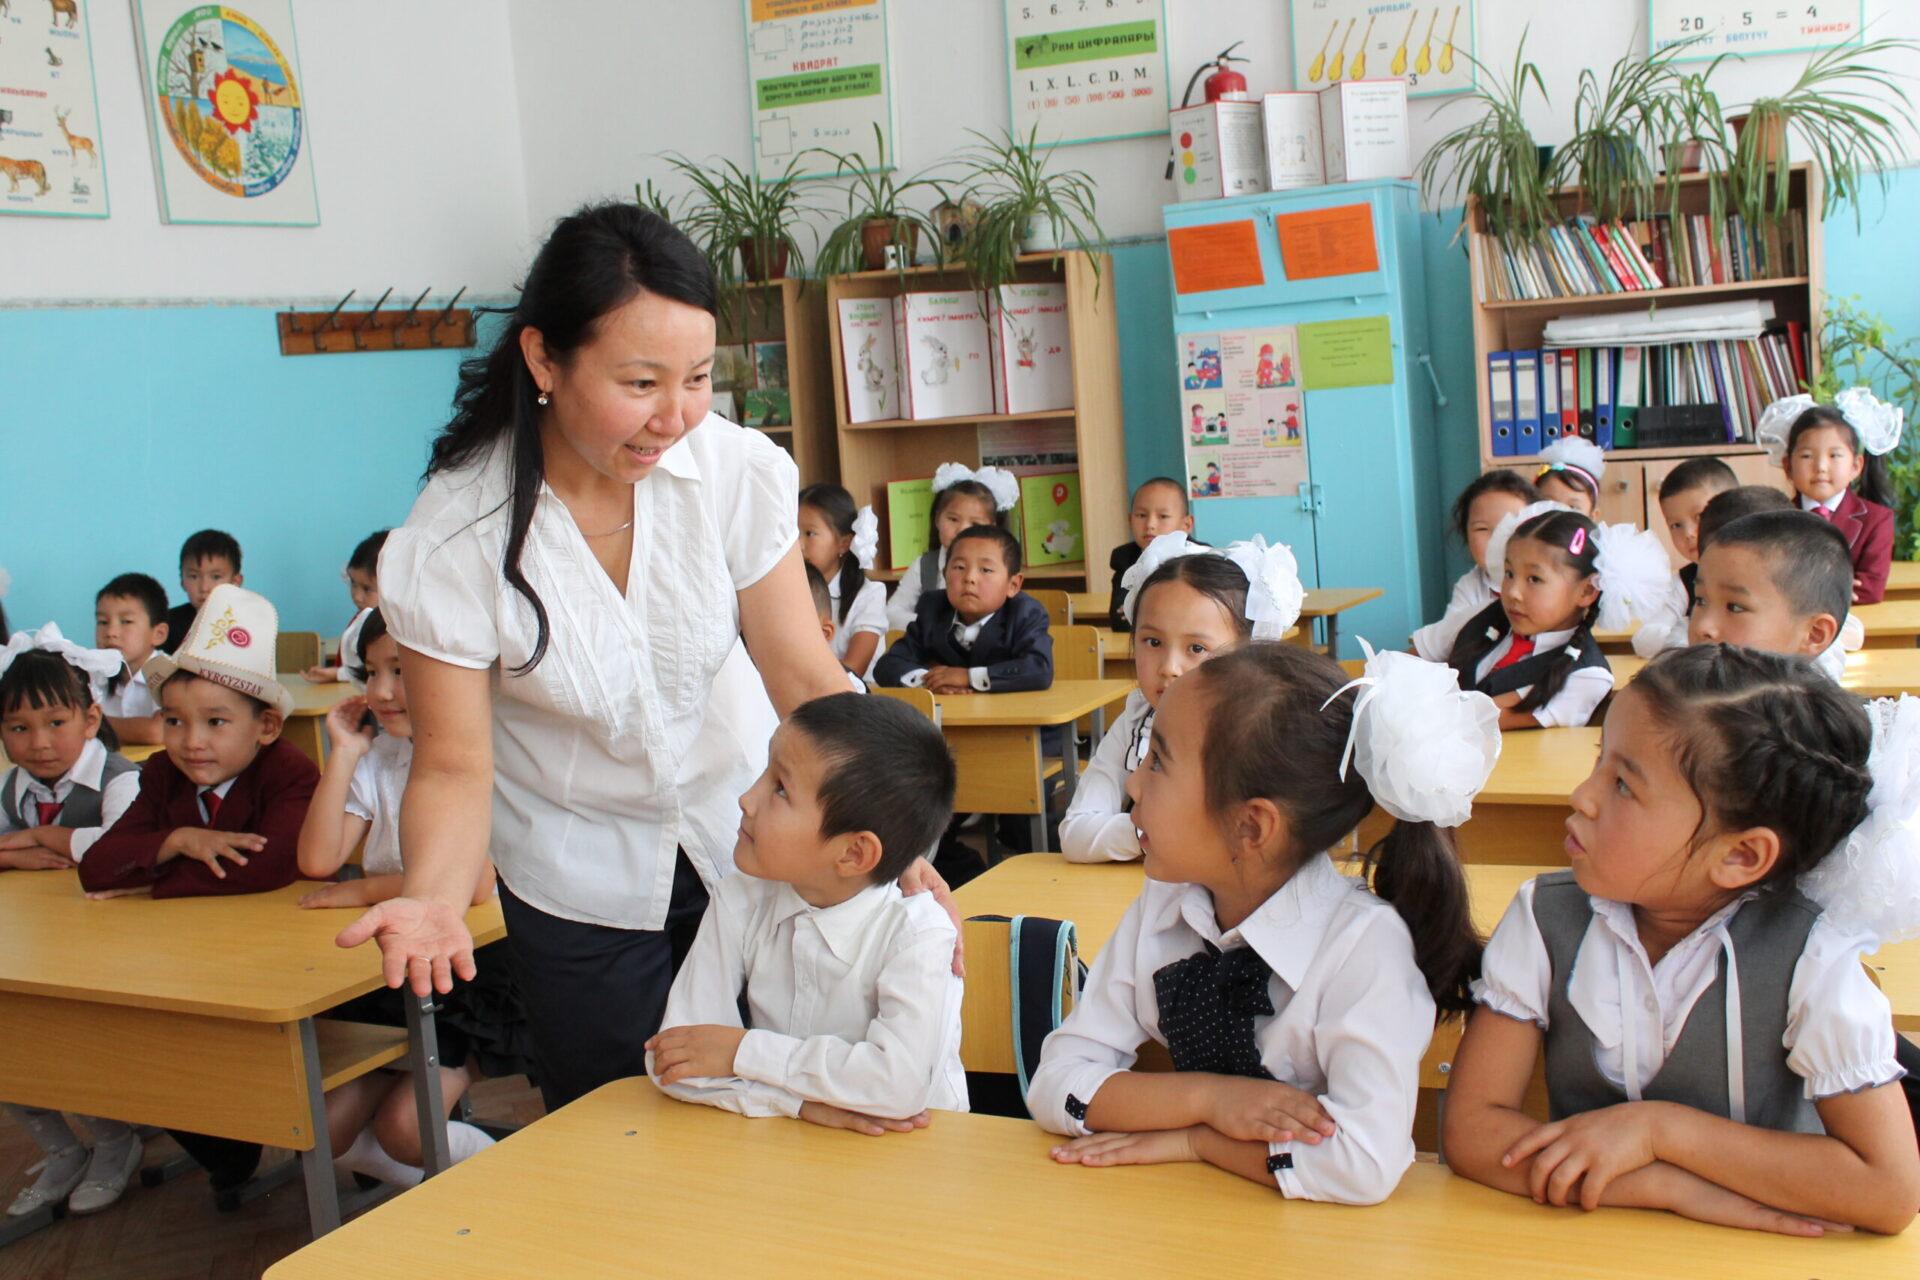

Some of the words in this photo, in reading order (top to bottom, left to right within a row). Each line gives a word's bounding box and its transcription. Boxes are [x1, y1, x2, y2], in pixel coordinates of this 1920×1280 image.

[1680, 17, 1704, 32] 20
[1742, 11, 1752, 26] 5
[1806, 5, 1817, 18] 4
[1409, 73, 1418, 86] 3
[200, 668, 264, 696] KYRGYZSTAN
